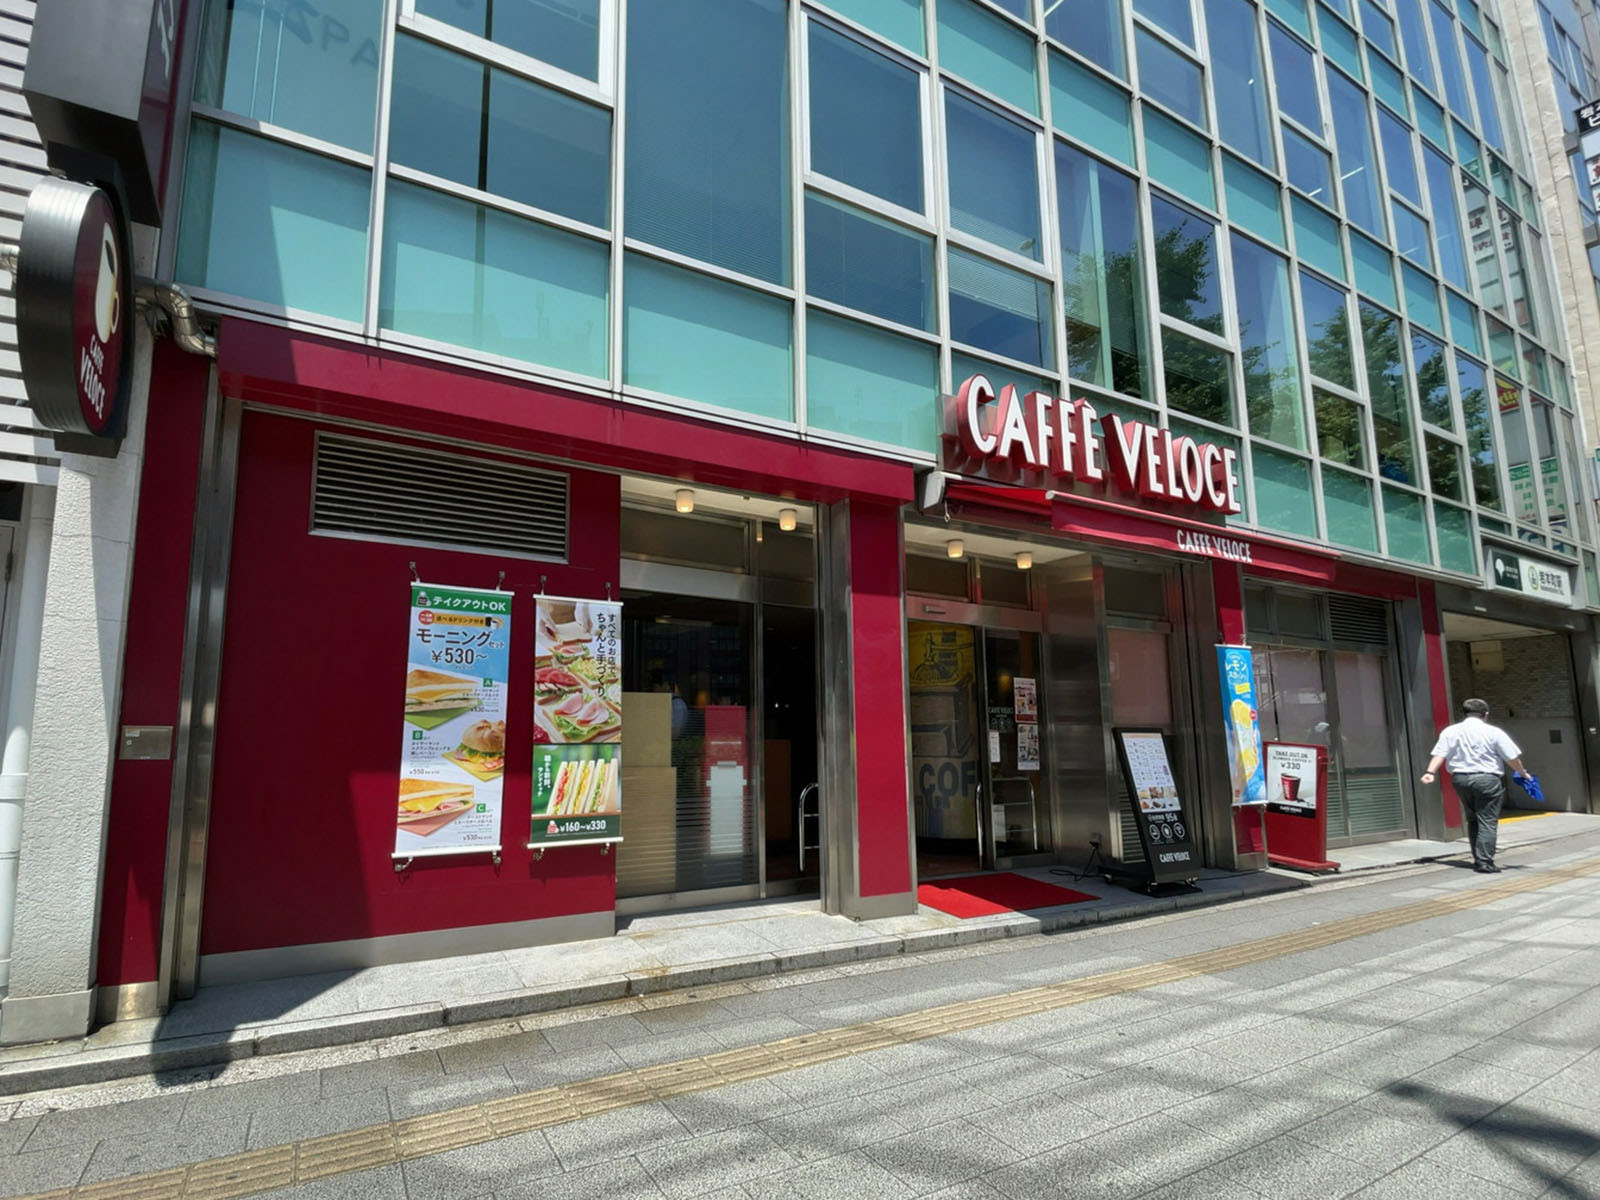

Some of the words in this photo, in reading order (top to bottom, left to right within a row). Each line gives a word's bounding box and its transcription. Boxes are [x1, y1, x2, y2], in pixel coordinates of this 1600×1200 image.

[80, 346, 106, 420] VELOCE
[1110, 413, 1242, 514] VELOCE
[1212, 535, 1253, 563] VELOCE
[432, 595, 507, 612] テイクアウトOK
[596, 612, 607, 697] ちゃんと手づくり
